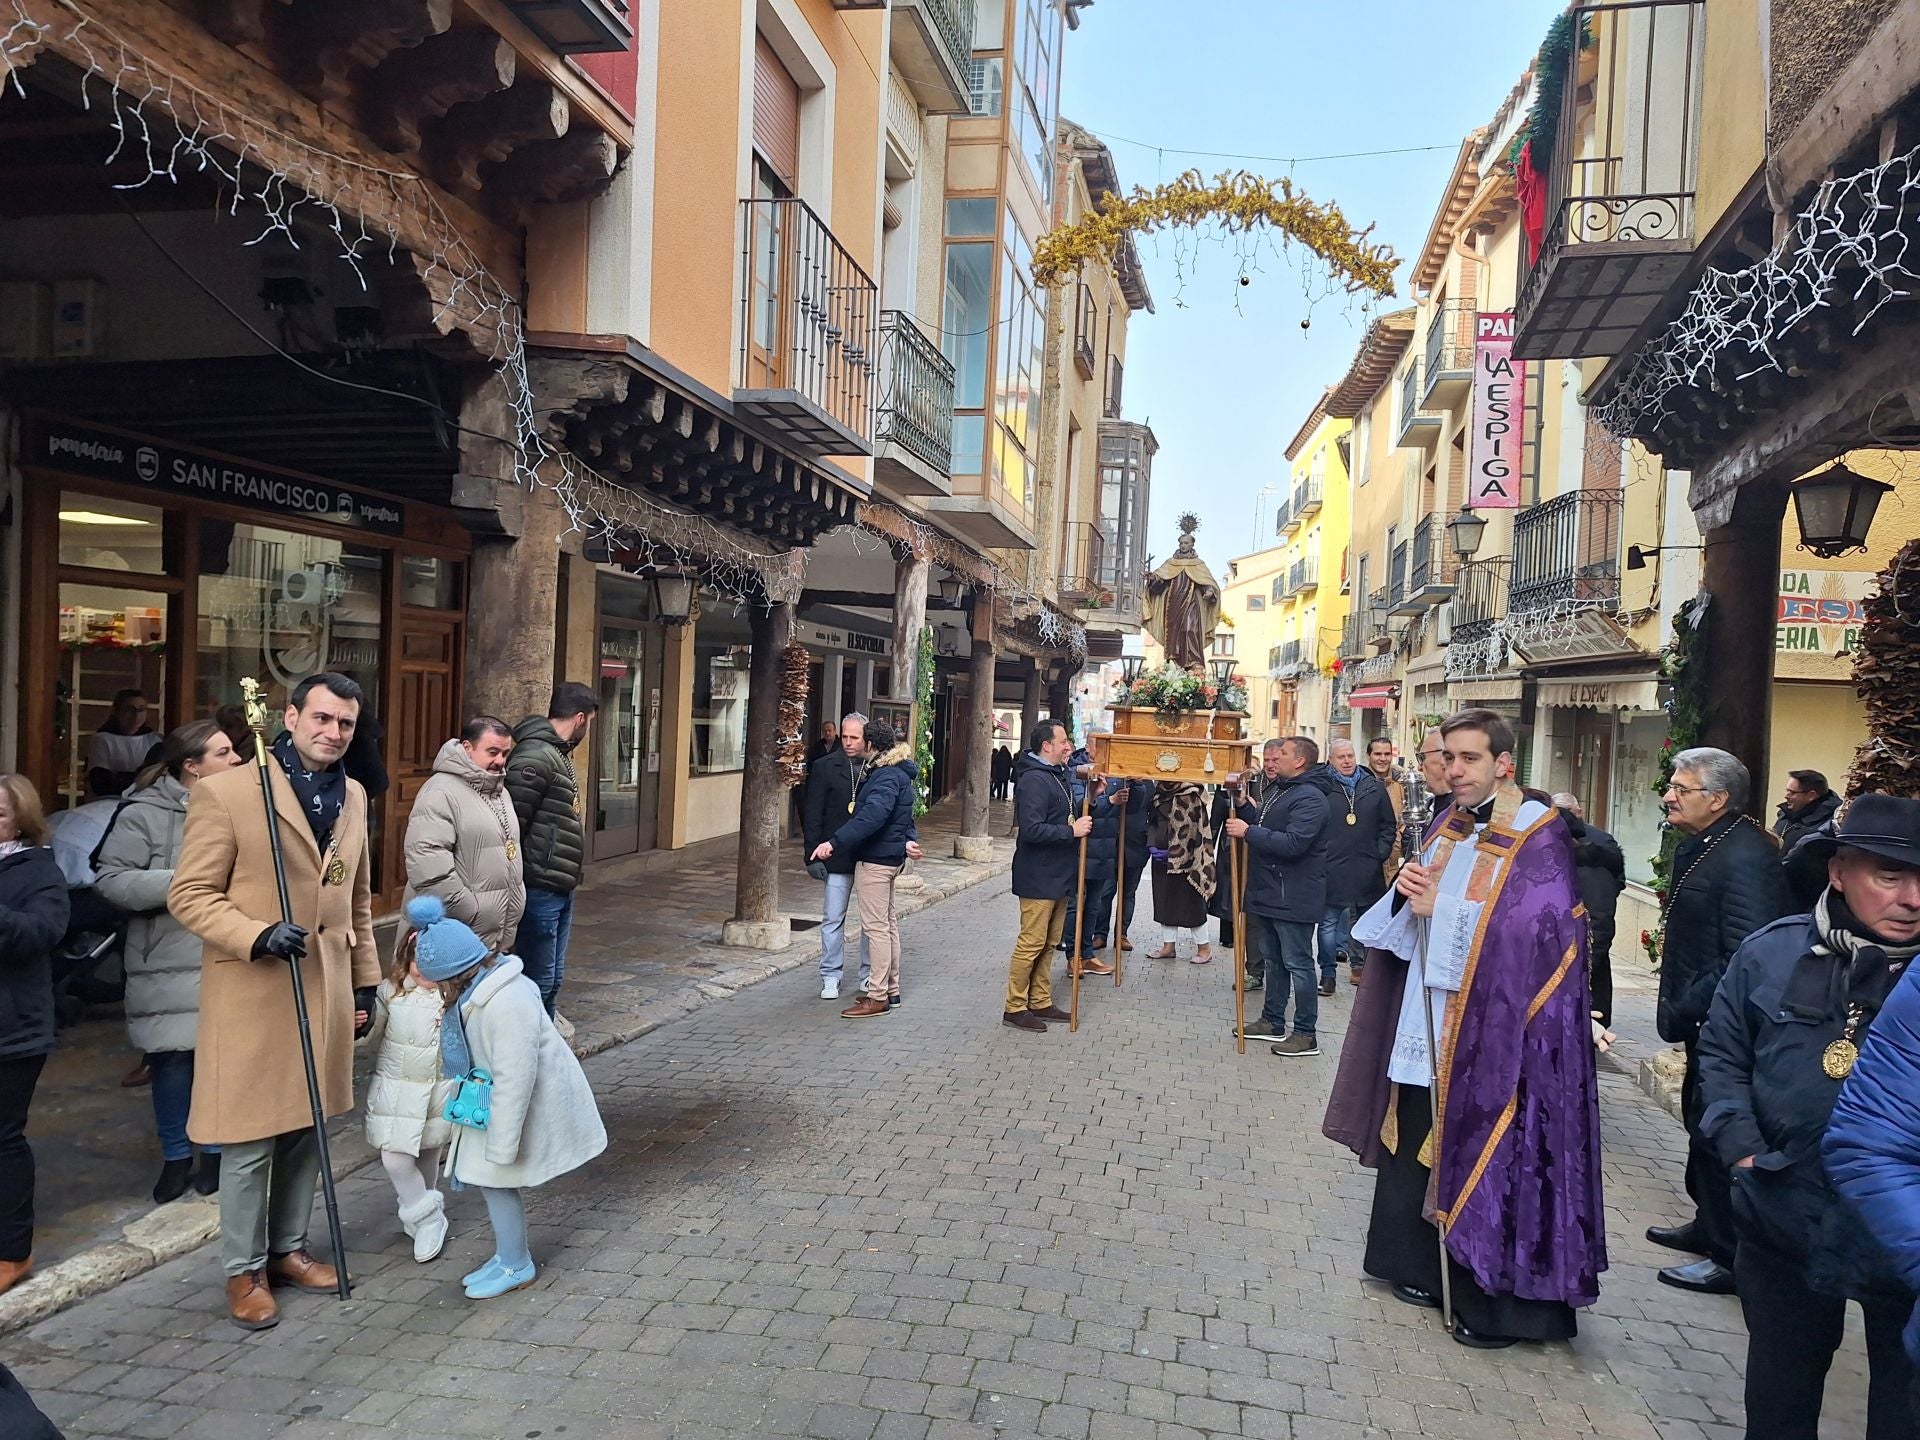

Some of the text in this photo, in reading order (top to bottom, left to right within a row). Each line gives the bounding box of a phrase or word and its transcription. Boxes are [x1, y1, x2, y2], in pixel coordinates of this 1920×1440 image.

[1480, 351, 1514, 497] LA ESPIGA
[172, 459, 216, 490] SAN
[222, 470, 329, 512] FRANCISCO
